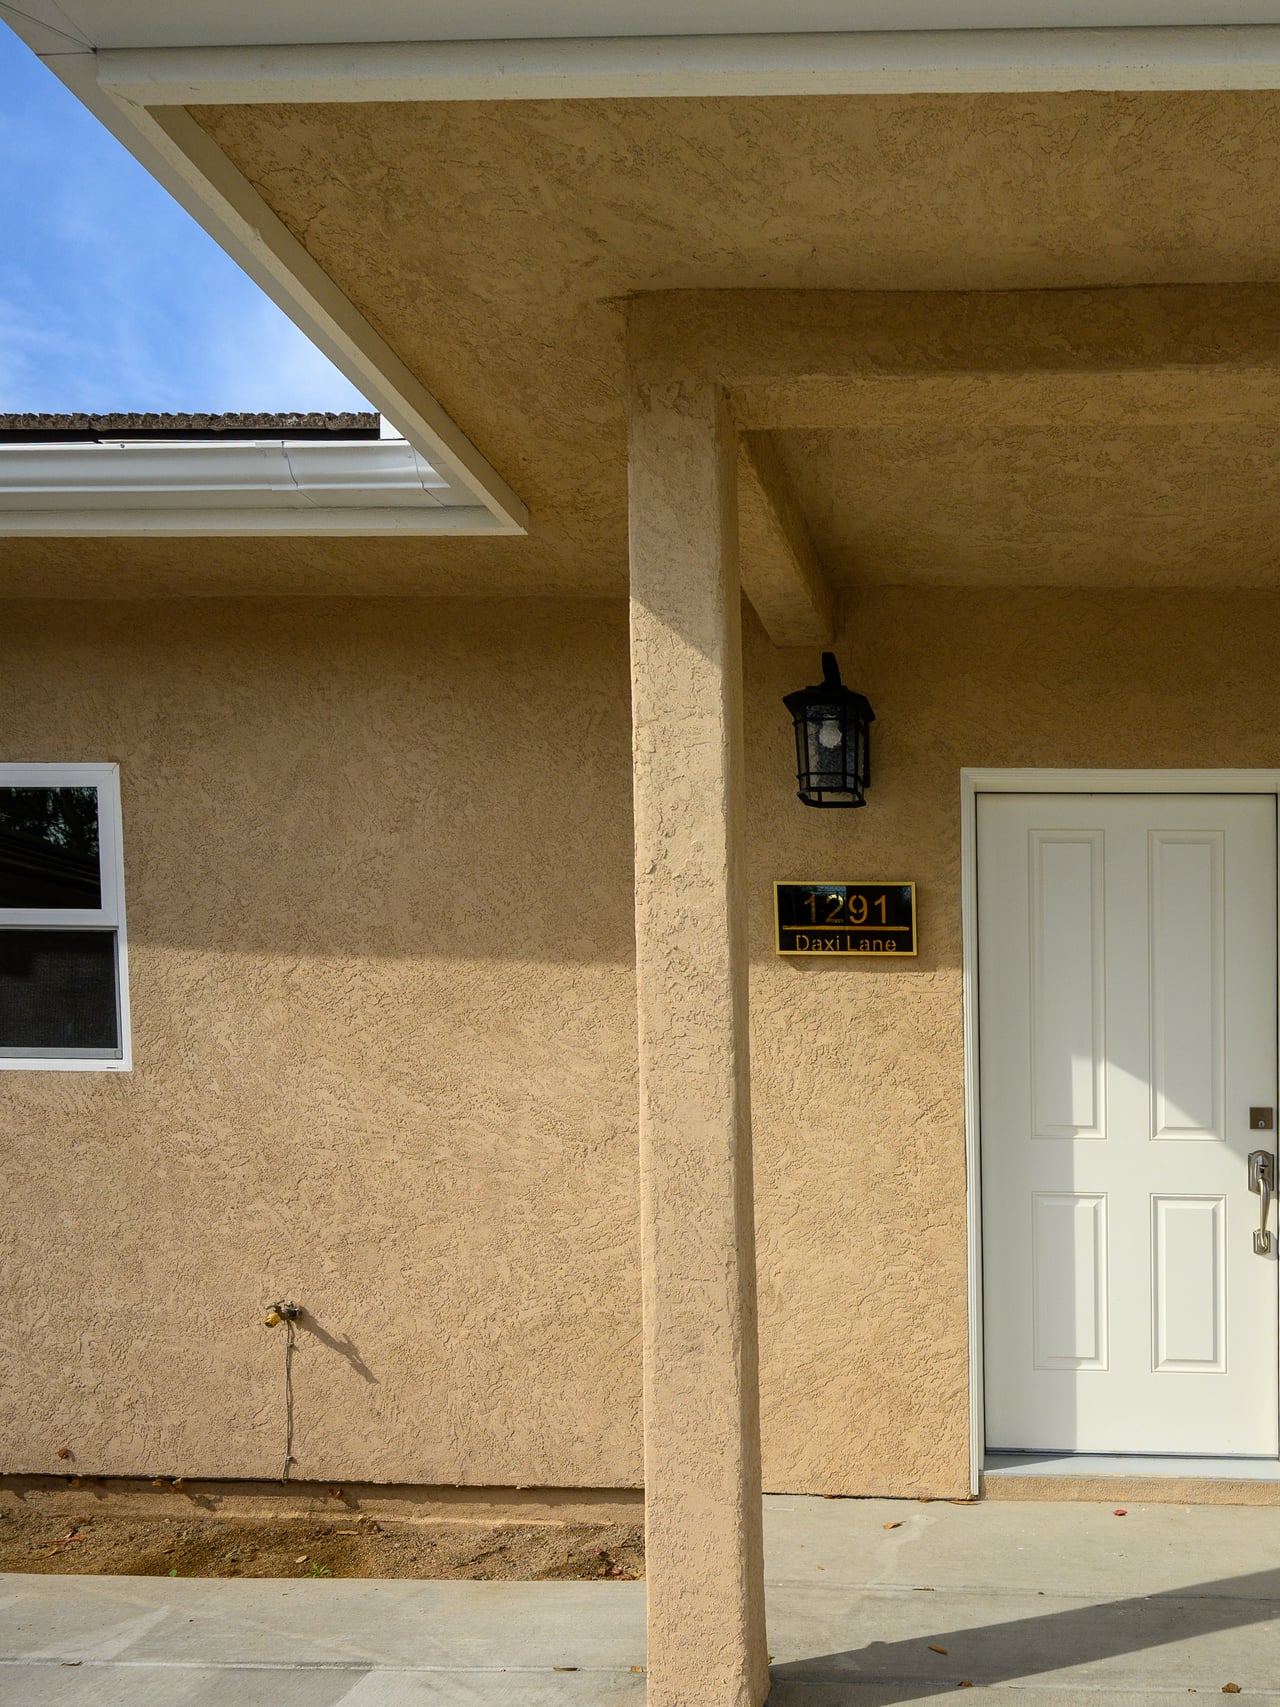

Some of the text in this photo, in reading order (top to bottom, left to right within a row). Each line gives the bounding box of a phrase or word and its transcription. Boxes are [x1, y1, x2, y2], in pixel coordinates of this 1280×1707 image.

[804, 894, 887, 924] 1291
[796, 934, 897, 952] Daxi Lane
